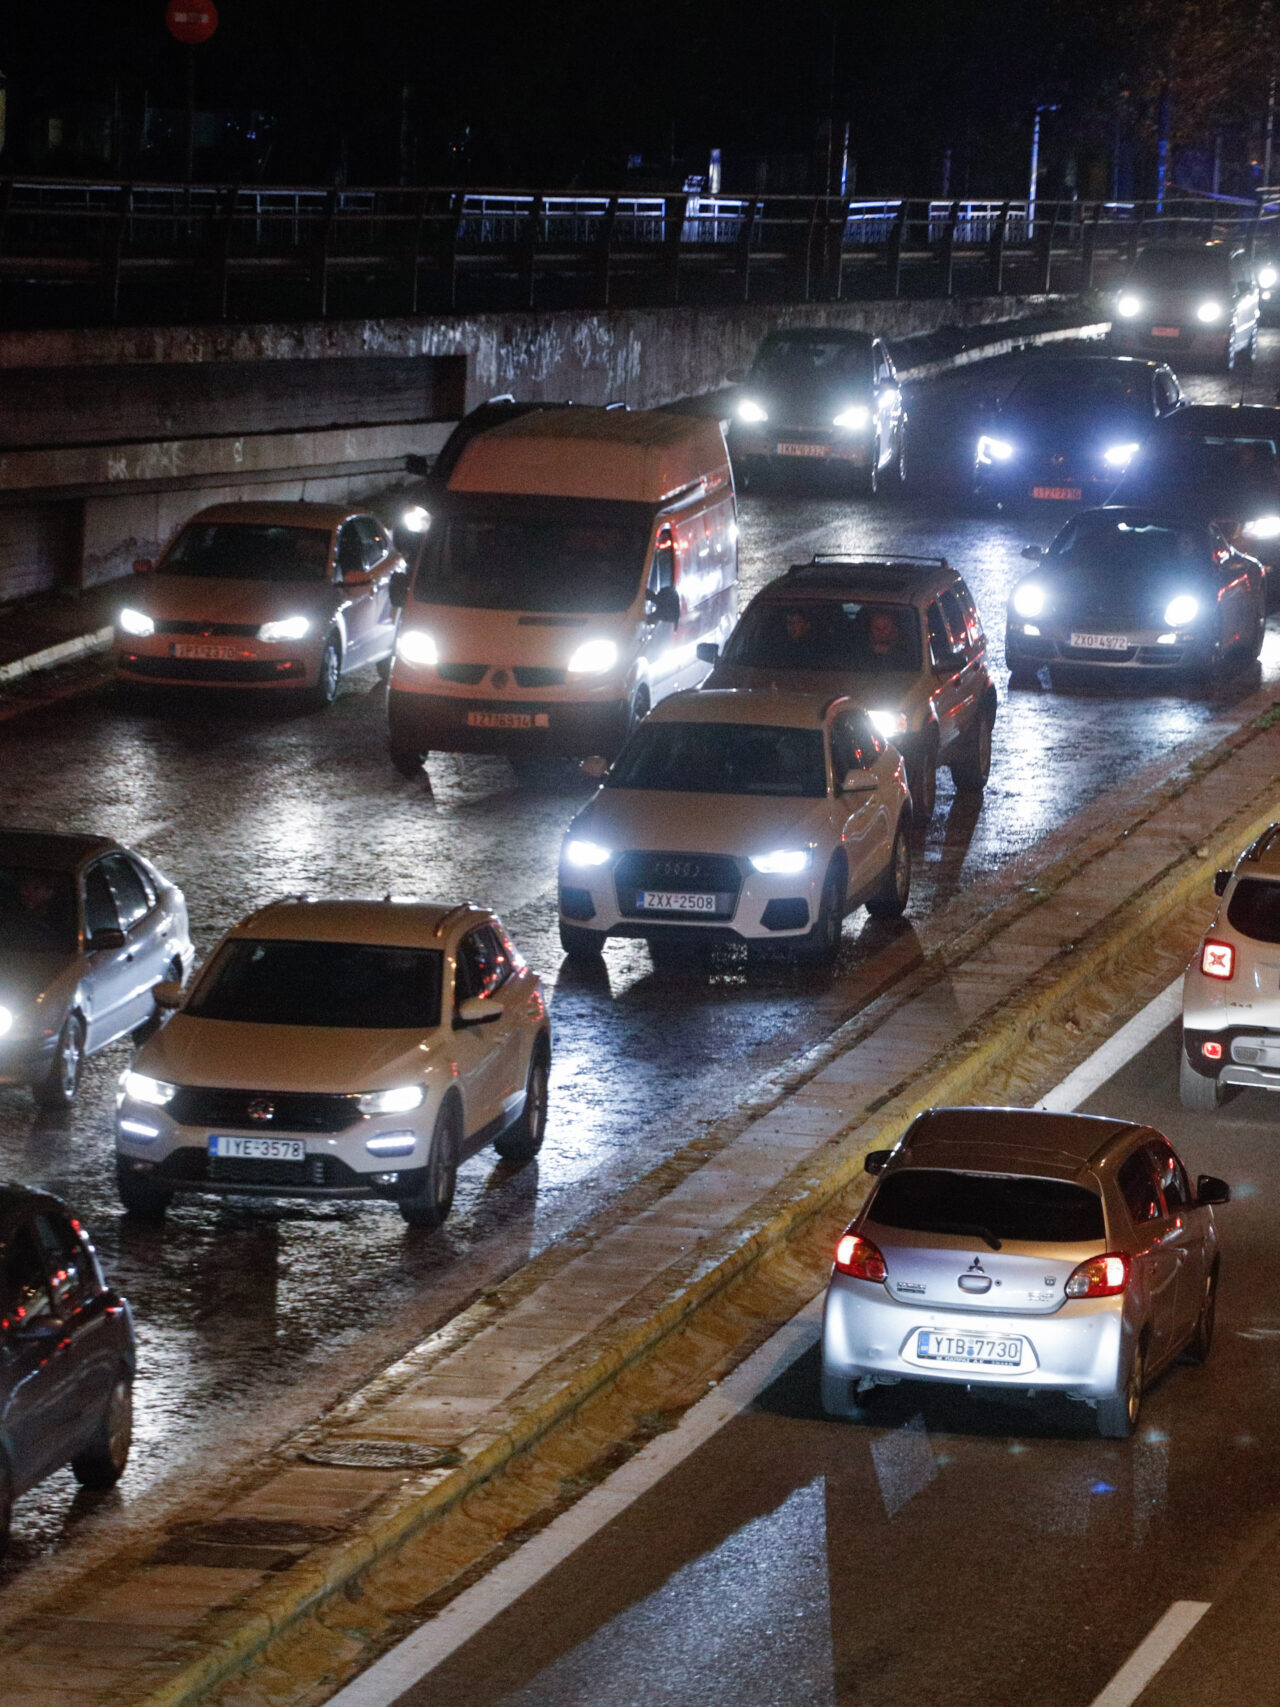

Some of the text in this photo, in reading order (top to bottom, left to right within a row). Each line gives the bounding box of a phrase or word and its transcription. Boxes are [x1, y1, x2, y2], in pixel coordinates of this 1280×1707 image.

[647, 893, 714, 910] ZXX-2508
[225, 1139, 301, 1158] IYE-3578
[934, 1337, 1019, 1359] YTB-7730
